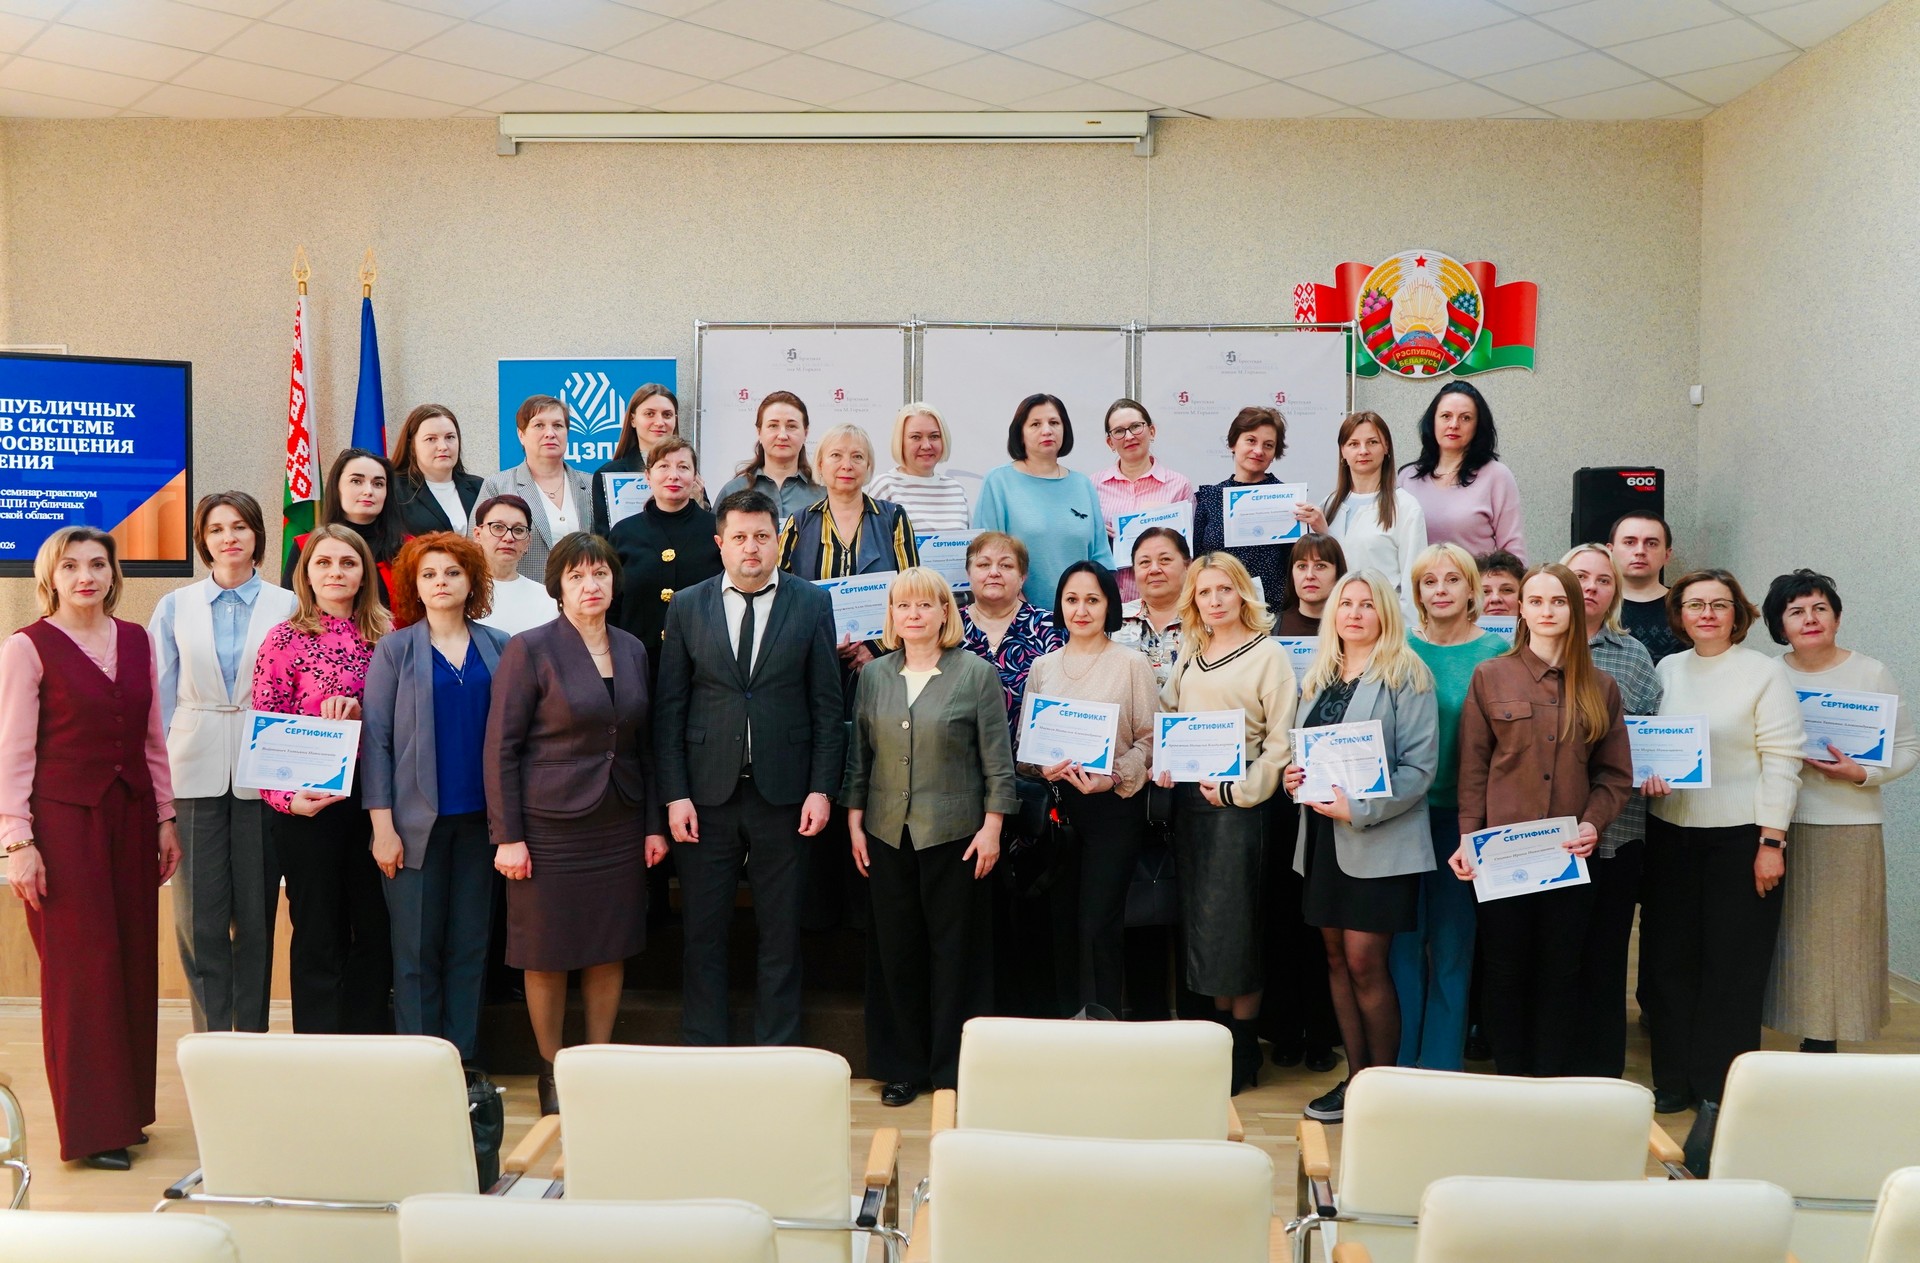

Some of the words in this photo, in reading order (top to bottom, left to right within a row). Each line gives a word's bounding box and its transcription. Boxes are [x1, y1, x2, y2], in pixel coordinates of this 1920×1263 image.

[1395, 349, 1442, 360] РЭСПУБЛІКА
[1399, 358, 1438, 367] БЕЛАРУСЬ
[0, 399, 135, 418] ПУБЛИЧНЫХ
[0, 417, 13, 432] В
[18, 418, 114, 435] СИСТЕМЕ
[0, 436, 134, 455] ОСВЕЩЕНИЯ
[564, 442, 619, 463] ЦЗП
[0, 454, 54, 470] ЕНИЯ
[1626, 477, 1654, 486] 600
[0, 489, 97, 500] семинар-практикум
[1251, 493, 1294, 501] СЕРТИФИКАТ
[29, 500, 85, 511] публичных
[25, 511, 65, 520] области
[1139, 512, 1179, 525] СЕРТИФИКАТ
[840, 583, 887, 595] СЕРТИФИКАТ
[1821, 700, 1879, 712] СЕРТИФИКАТ
[1059, 710, 1107, 721] СЕРТИФИКАТ
[1188, 722, 1234, 730] СЕРТИФИКАТ
[1638, 727, 1694, 735] СЕРТИФИКАТ
[285, 727, 343, 739] СЕРТИФИКАТ
[1503, 827, 1561, 843] СЕРТИФИКАТ
